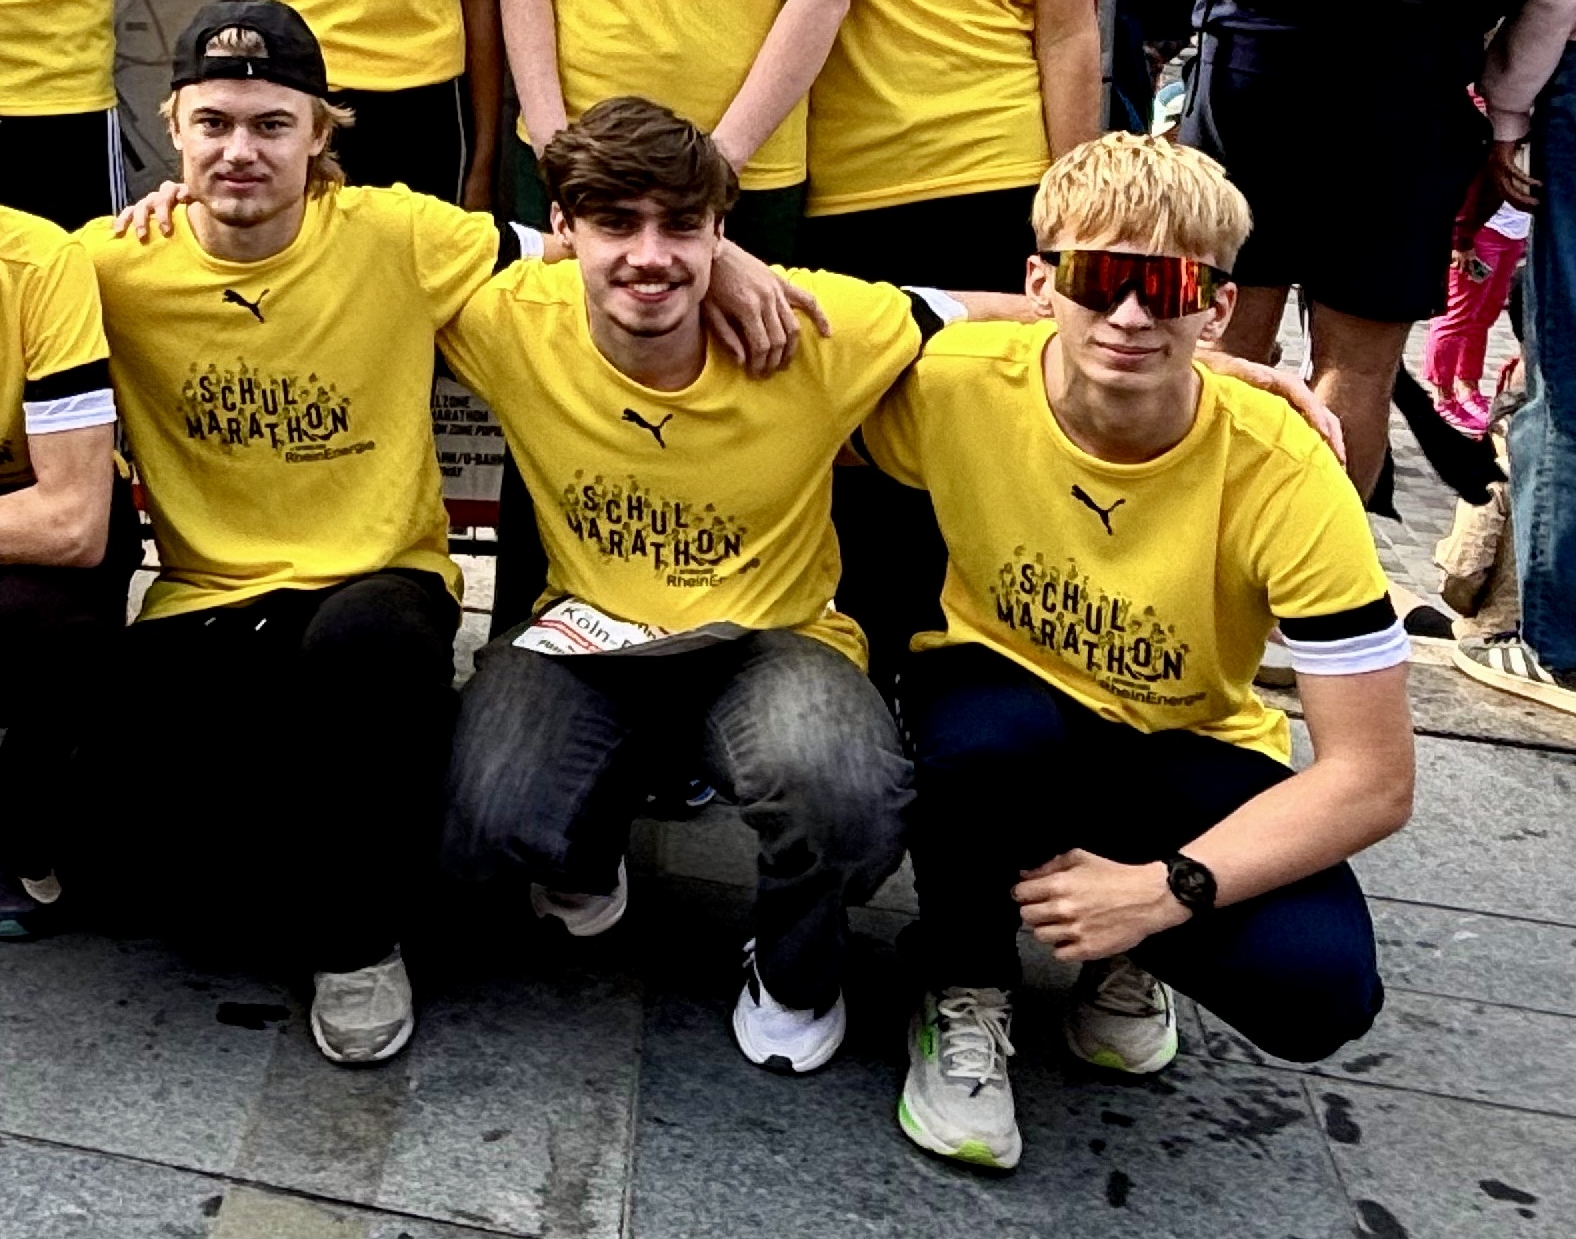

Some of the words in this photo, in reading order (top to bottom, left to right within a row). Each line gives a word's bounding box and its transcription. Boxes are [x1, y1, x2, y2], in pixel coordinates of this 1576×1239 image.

[199, 375, 298, 415] SCHUL
[185, 402, 349, 449] MARATHON
[582, 486, 688, 535] SCHUL
[566, 511, 741, 570] MARATHON
[1019, 563, 1127, 635] SCHUL
[995, 594, 1184, 682] MARATHON
